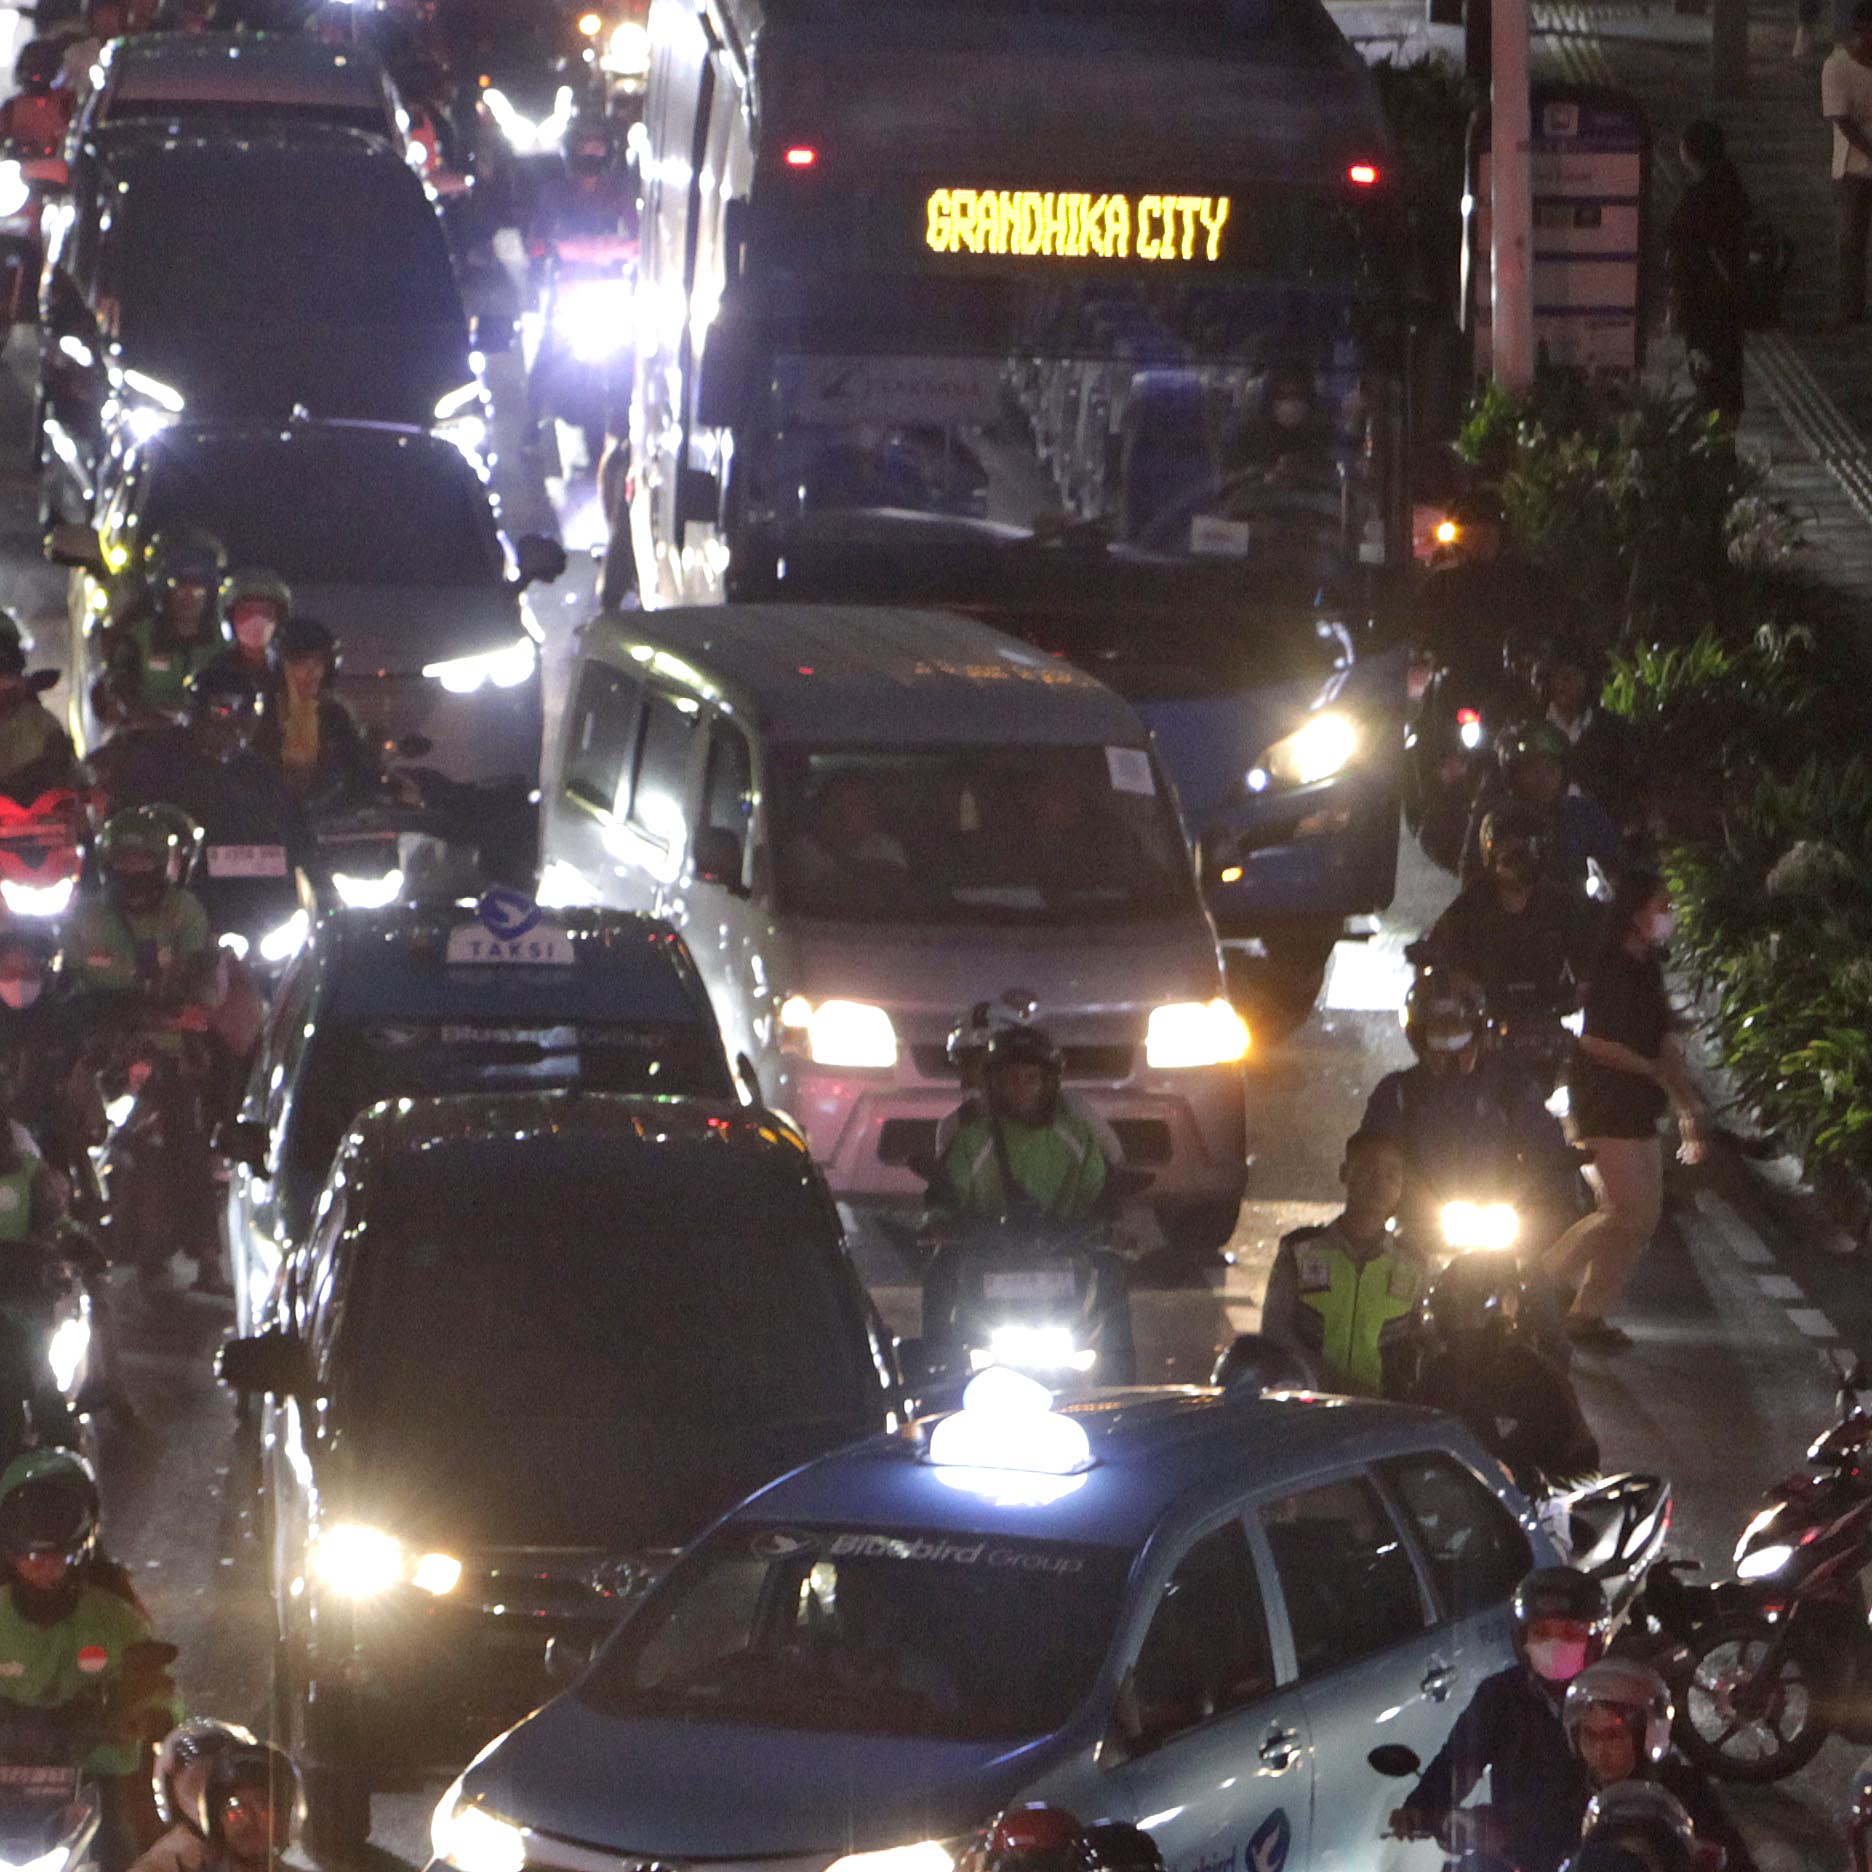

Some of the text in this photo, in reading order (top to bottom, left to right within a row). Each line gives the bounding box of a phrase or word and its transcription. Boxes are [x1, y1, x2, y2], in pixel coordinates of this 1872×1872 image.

[926, 188, 1232, 262] GRANDHIKA CITY
[470, 941, 554, 958] TAKSI
[988, 1549, 1087, 1575] Group
